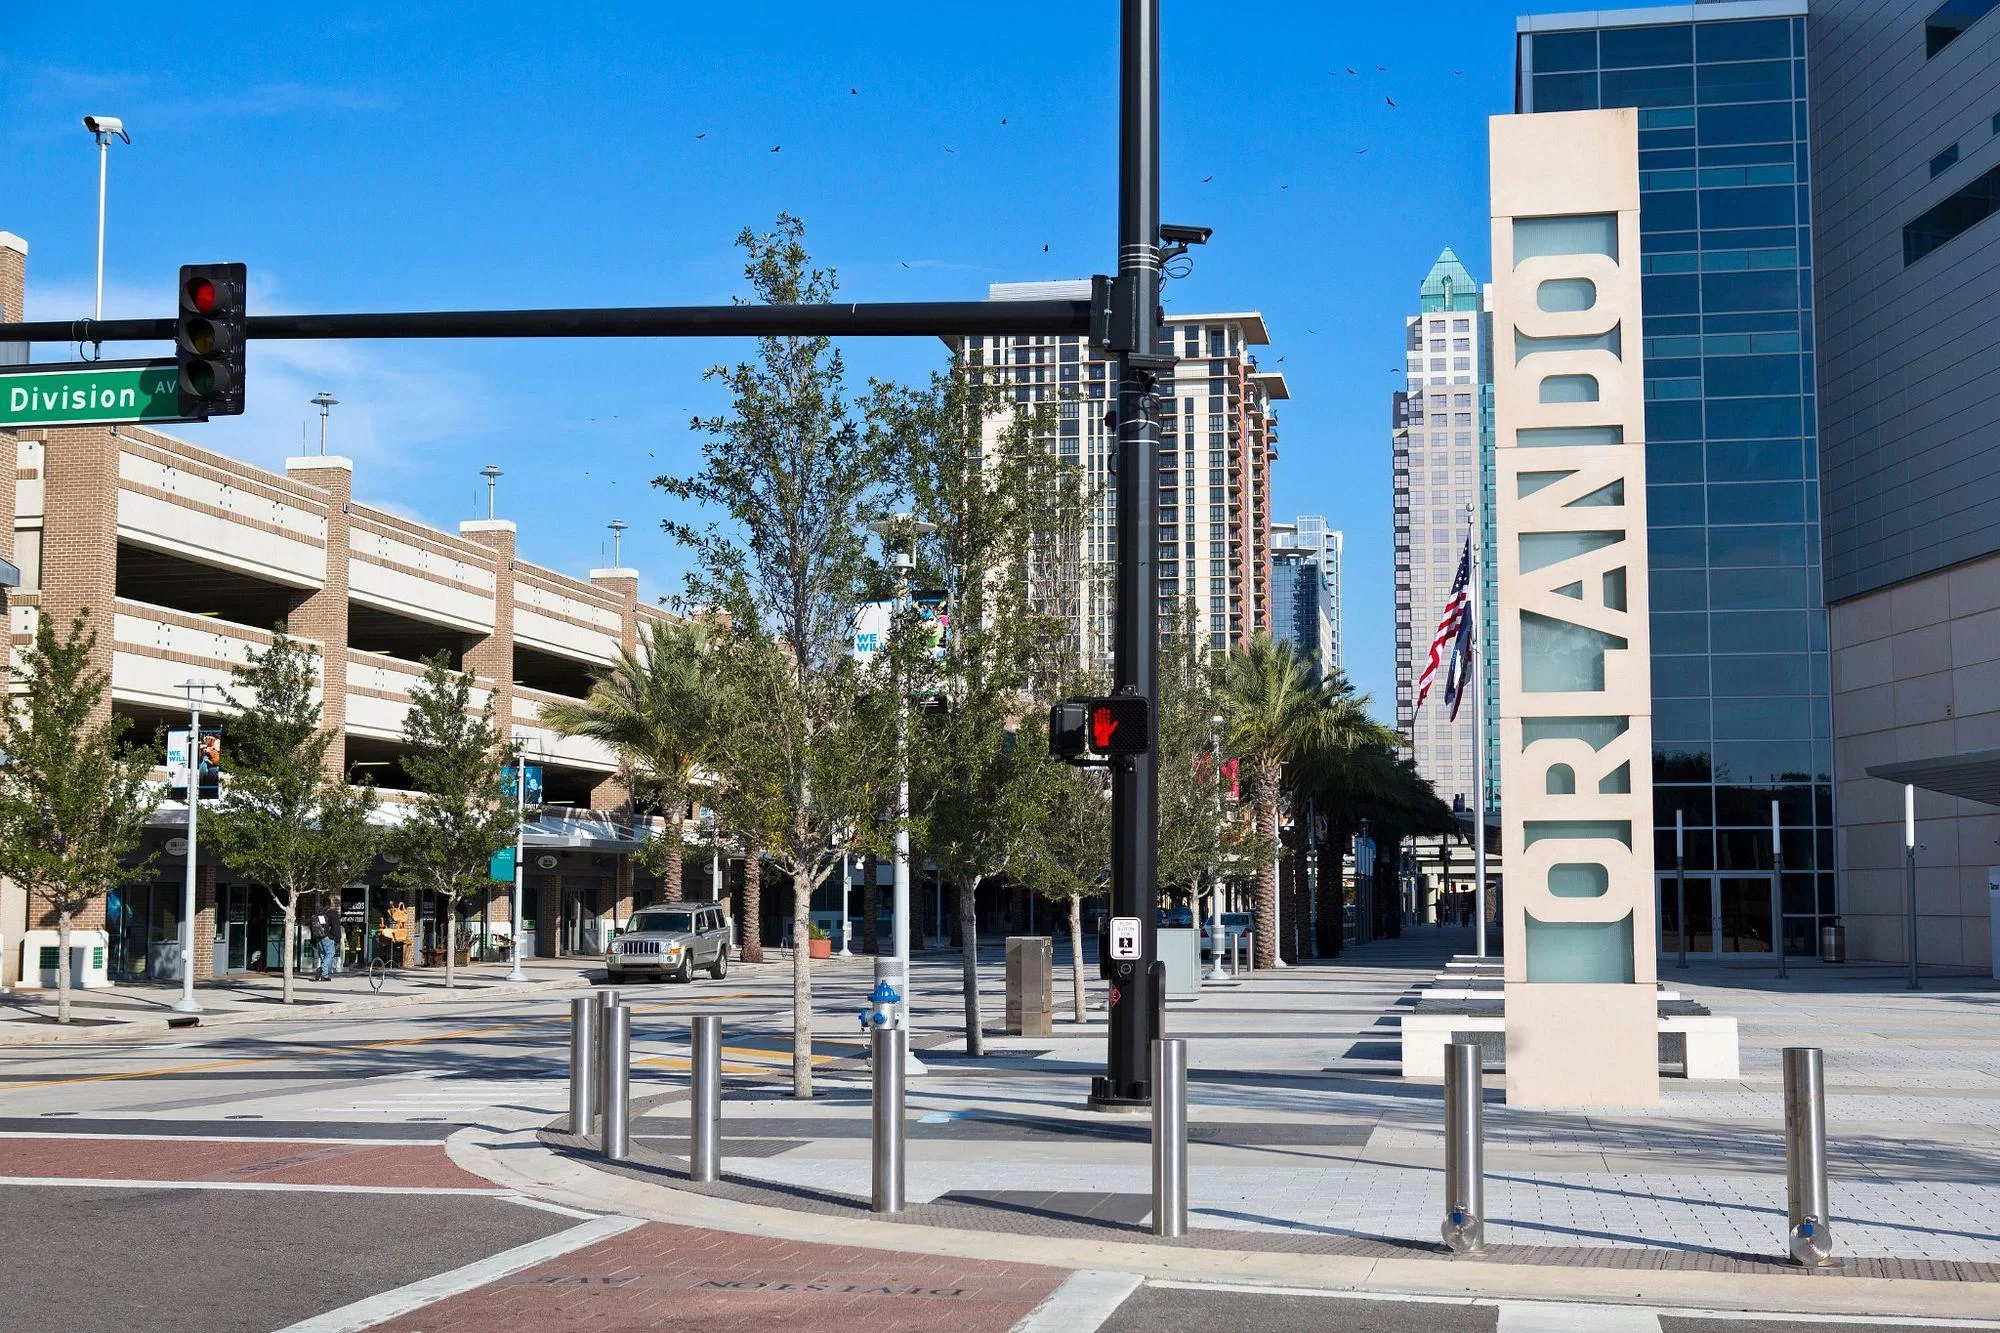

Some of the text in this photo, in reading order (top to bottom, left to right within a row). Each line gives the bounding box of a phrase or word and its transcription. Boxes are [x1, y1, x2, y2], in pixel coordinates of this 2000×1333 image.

[10, 380, 176, 412] Division AV
[1513, 252, 1634, 924] ORLANDO
[857, 633, 876, 643] WE
[528, 1273, 968, 1297] DIVISION AVE
